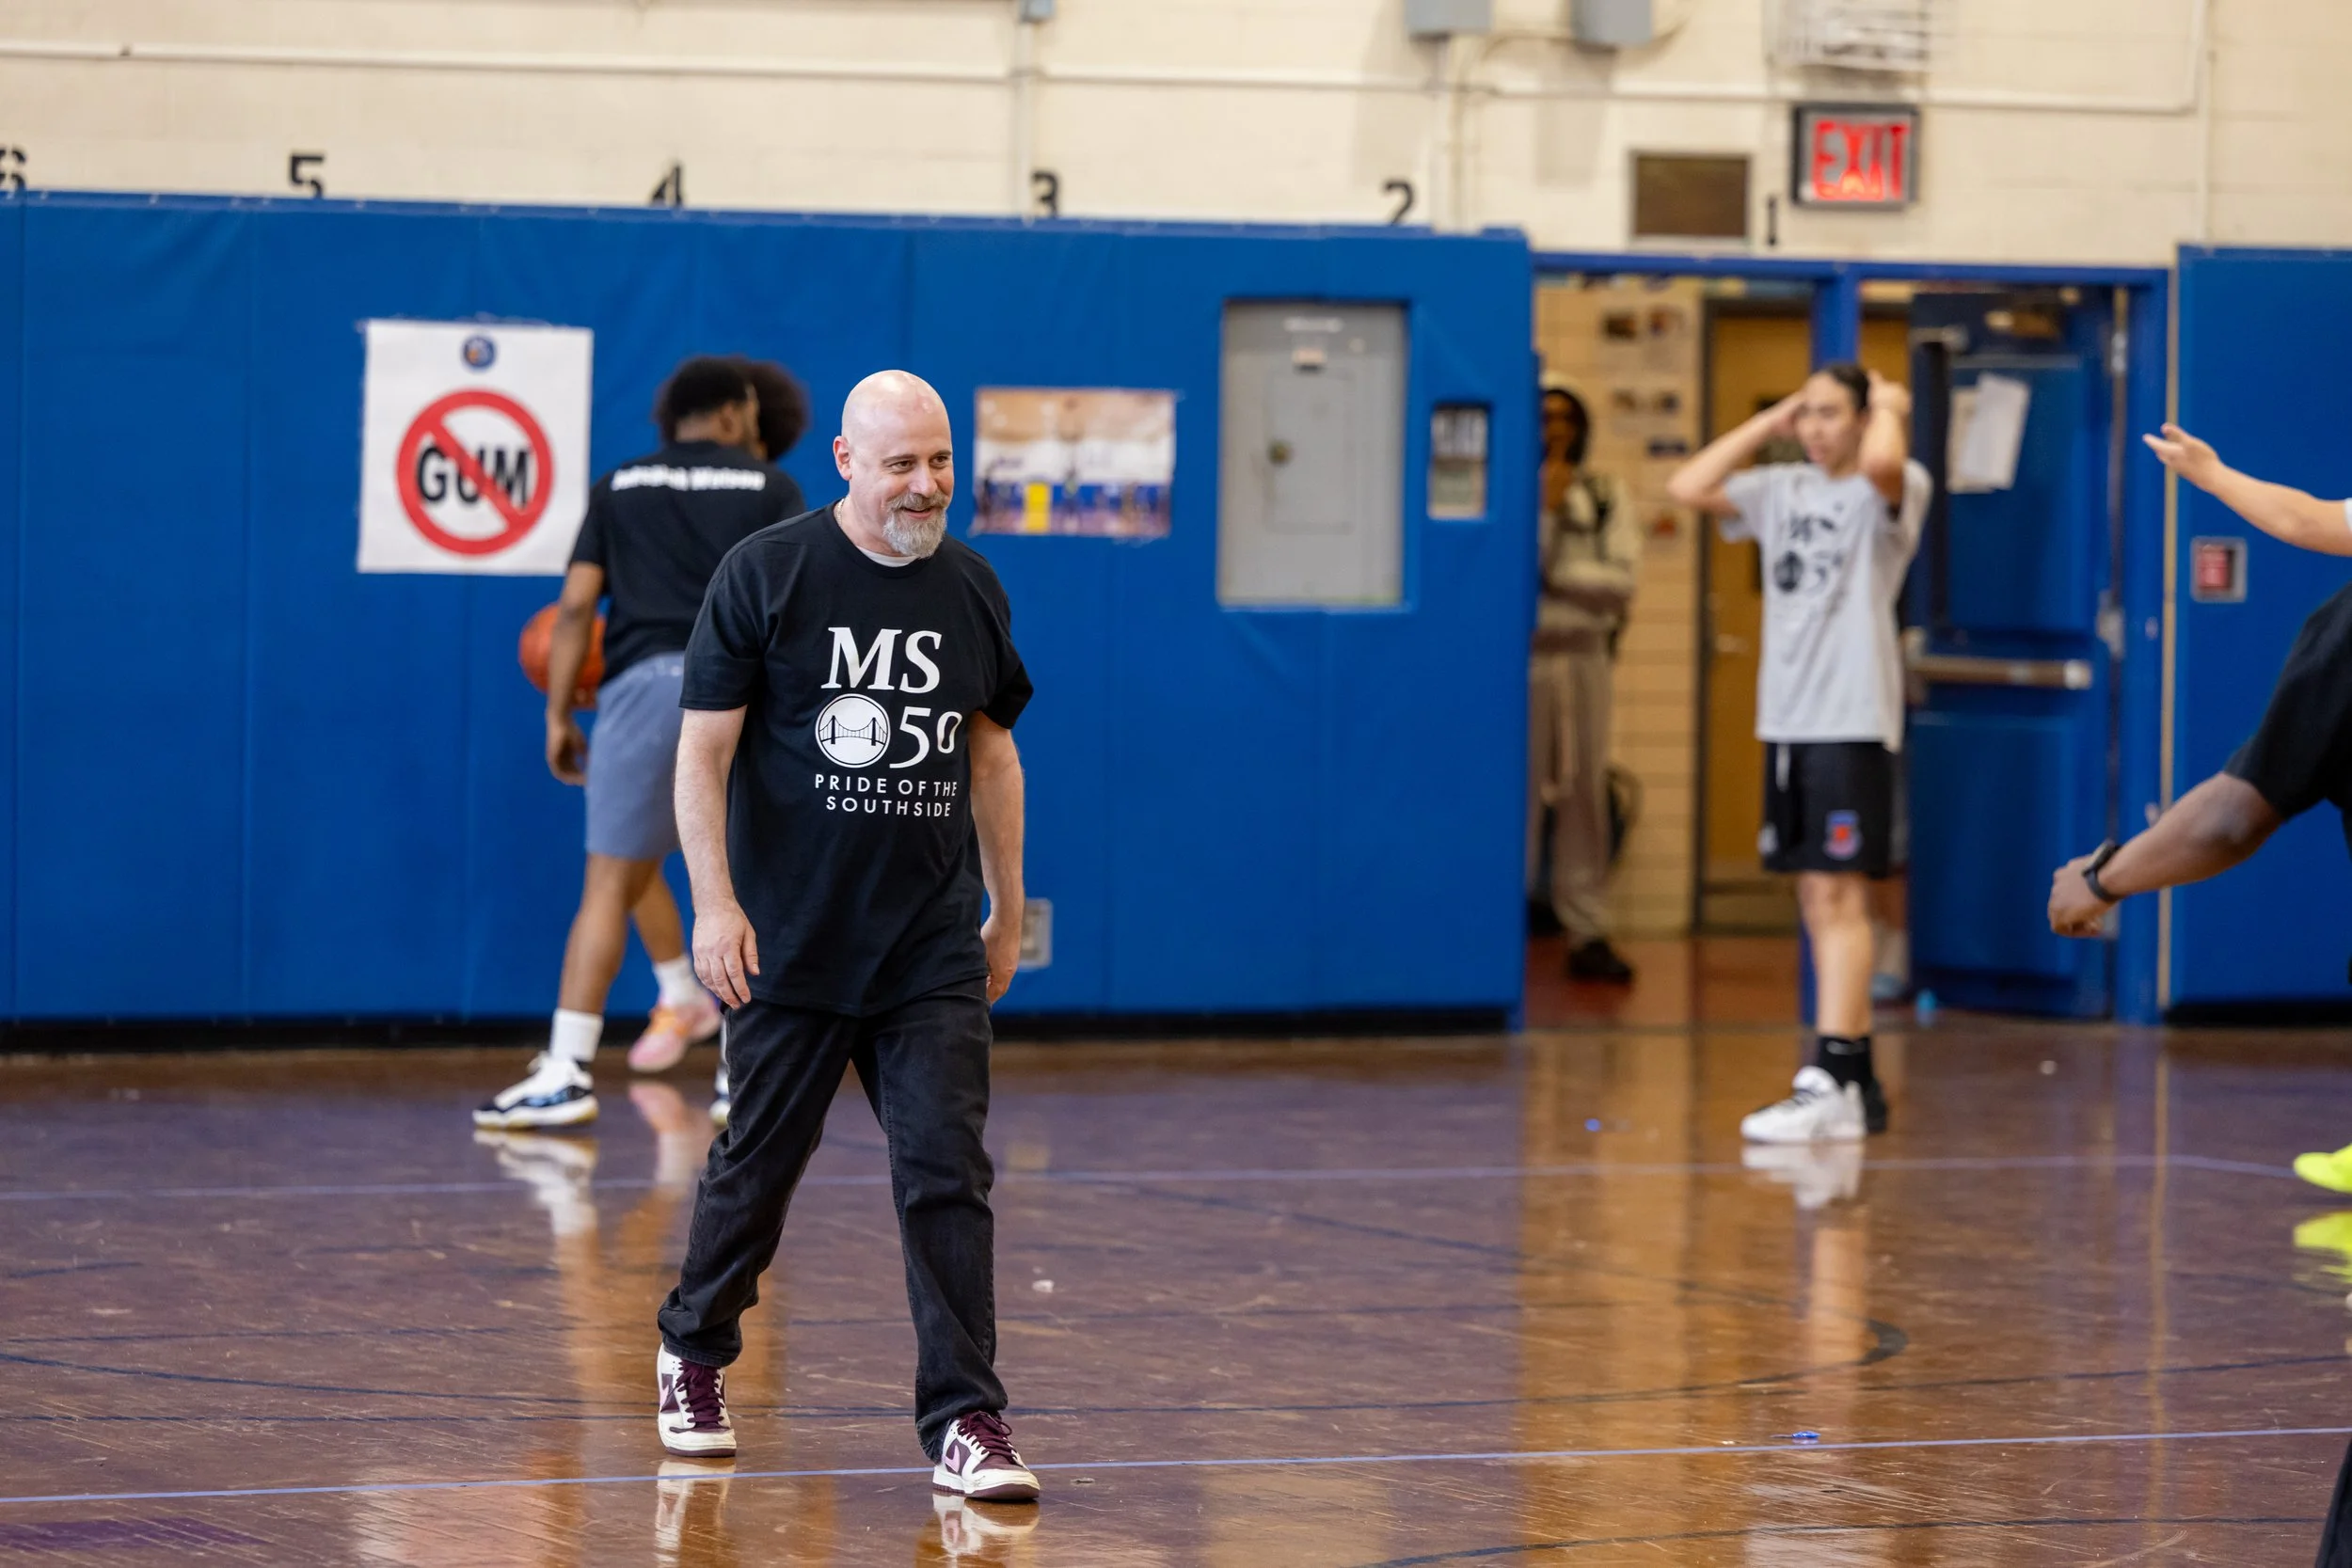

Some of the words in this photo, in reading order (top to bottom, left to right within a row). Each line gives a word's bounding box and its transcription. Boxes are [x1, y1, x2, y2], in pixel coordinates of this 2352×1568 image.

[288, 152, 326, 197] 5
[1812, 119, 1909, 201] EXIT
[1031, 169, 1060, 216] 3
[1385, 180, 1416, 225] 2
[418, 445, 529, 510] GUM
[820, 626, 943, 694] MS
[888, 705, 963, 769] 50
[815, 773, 887, 794] PRIDE
[898, 779, 928, 796] OF
[933, 781, 958, 797] THE
[825, 795, 952, 817] SOUTHSIDE
